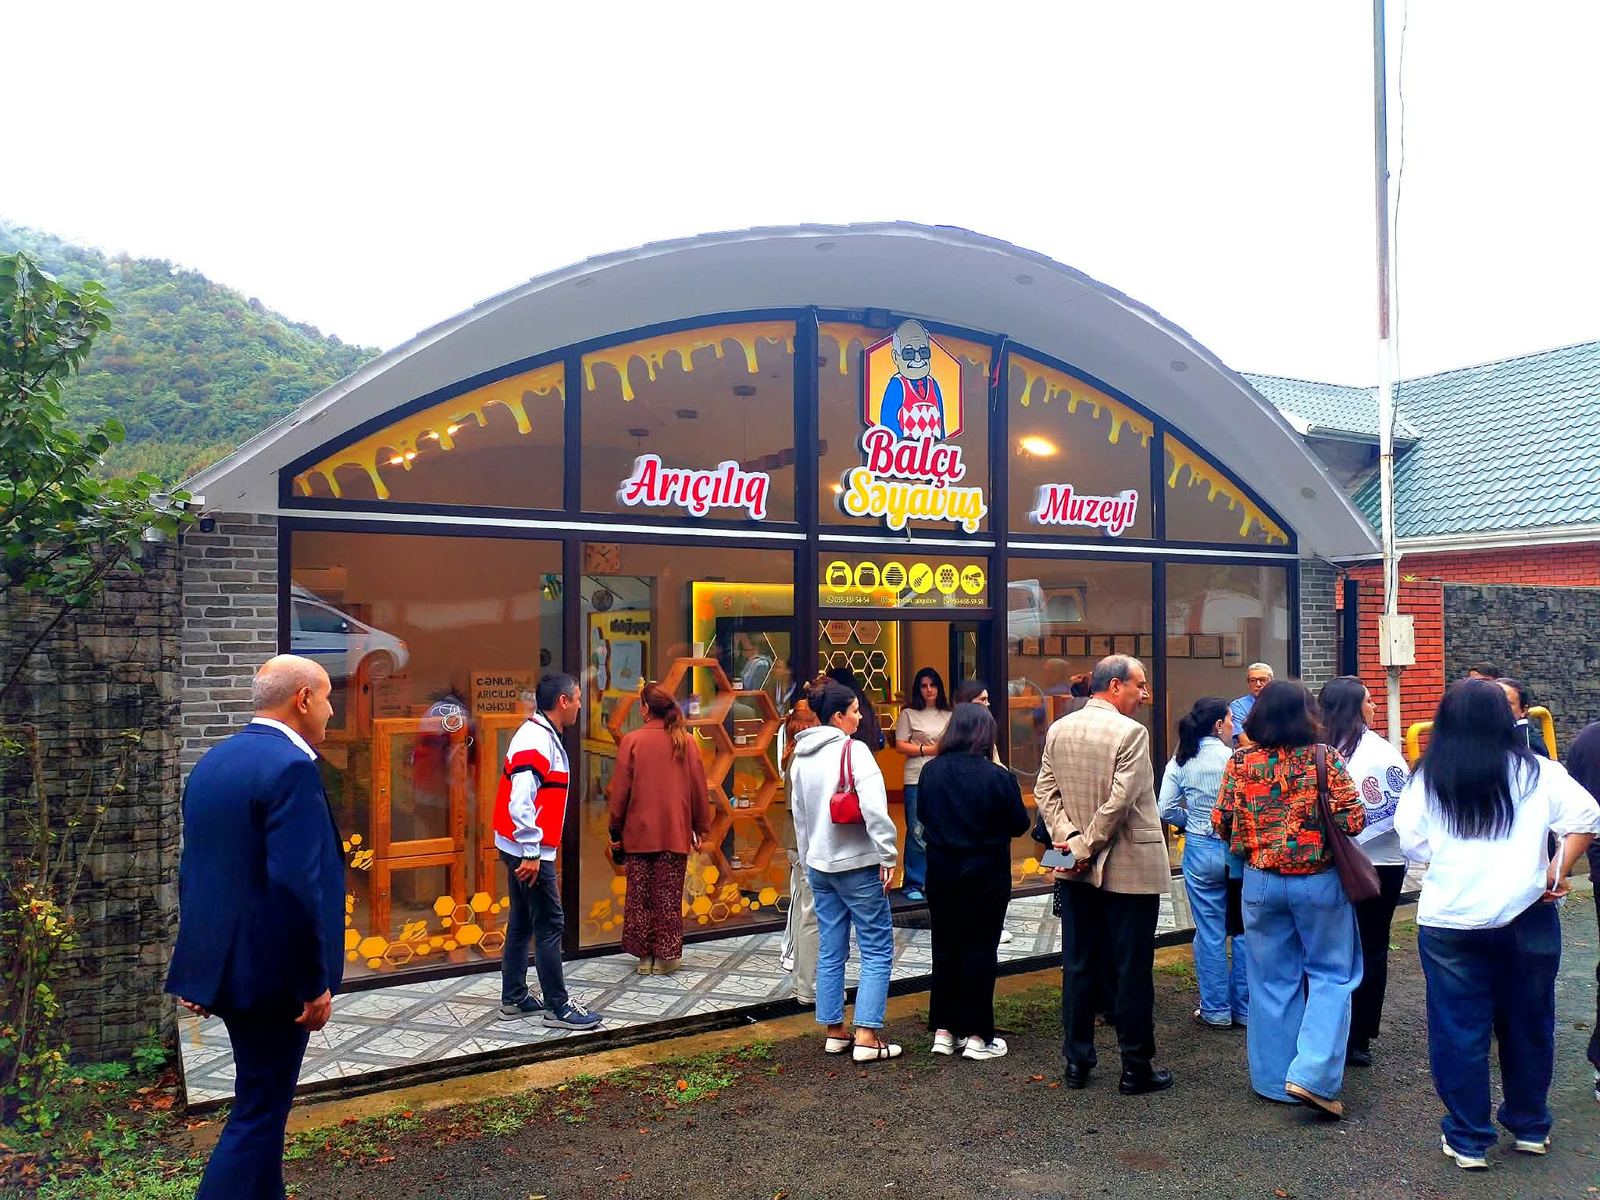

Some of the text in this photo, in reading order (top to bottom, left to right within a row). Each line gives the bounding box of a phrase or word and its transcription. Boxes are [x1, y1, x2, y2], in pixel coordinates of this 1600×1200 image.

[623, 457, 768, 517] Arıçılıq
[864, 428, 963, 490] Balçı
[846, 469, 986, 531] Səyavuş
[1038, 485, 1137, 534] Muzeyi
